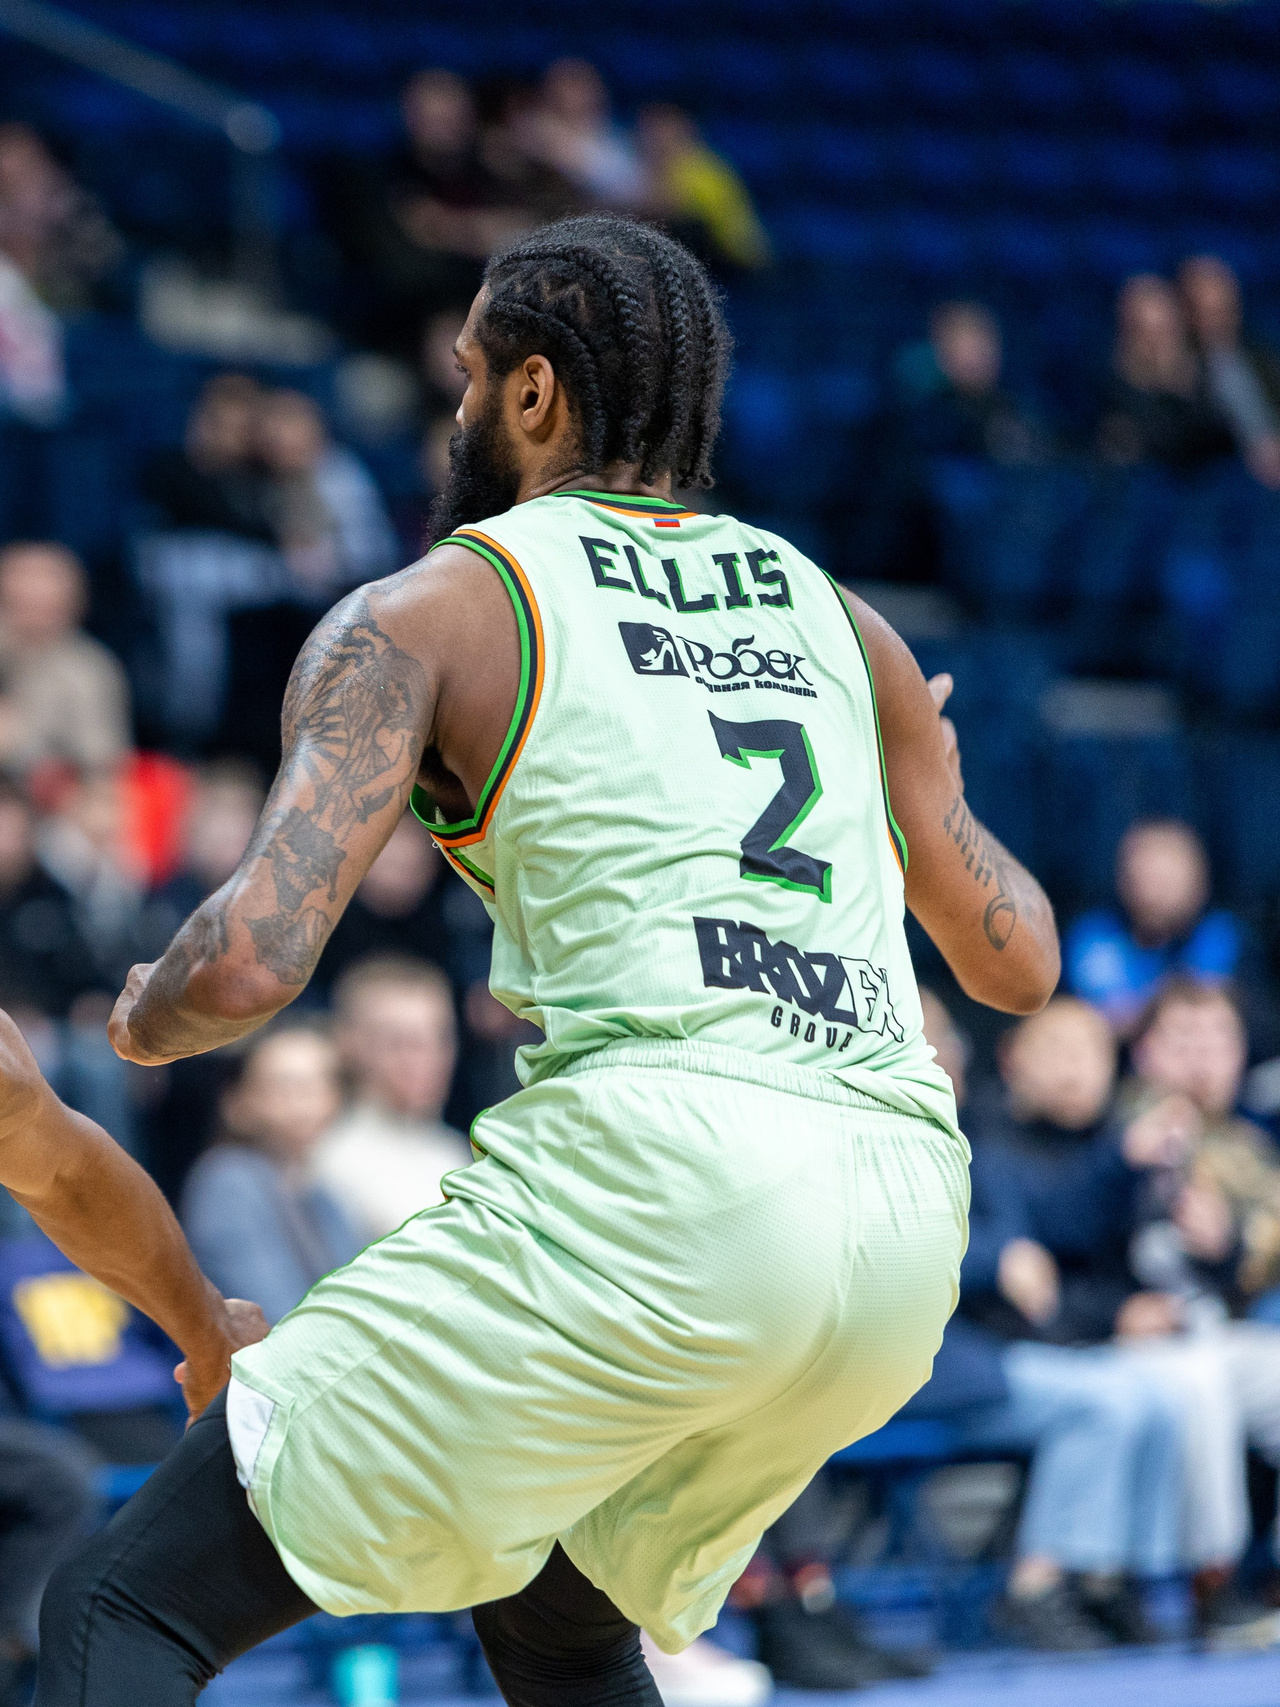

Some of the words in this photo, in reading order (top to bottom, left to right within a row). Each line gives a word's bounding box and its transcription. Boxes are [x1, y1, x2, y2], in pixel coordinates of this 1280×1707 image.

[578, 535, 794, 613] ELLIS
[676, 634, 813, 686] Робек
[754, 679, 818, 698] компания
[707, 709, 832, 904] 2
[770, 1005, 853, 1052] GROUP
